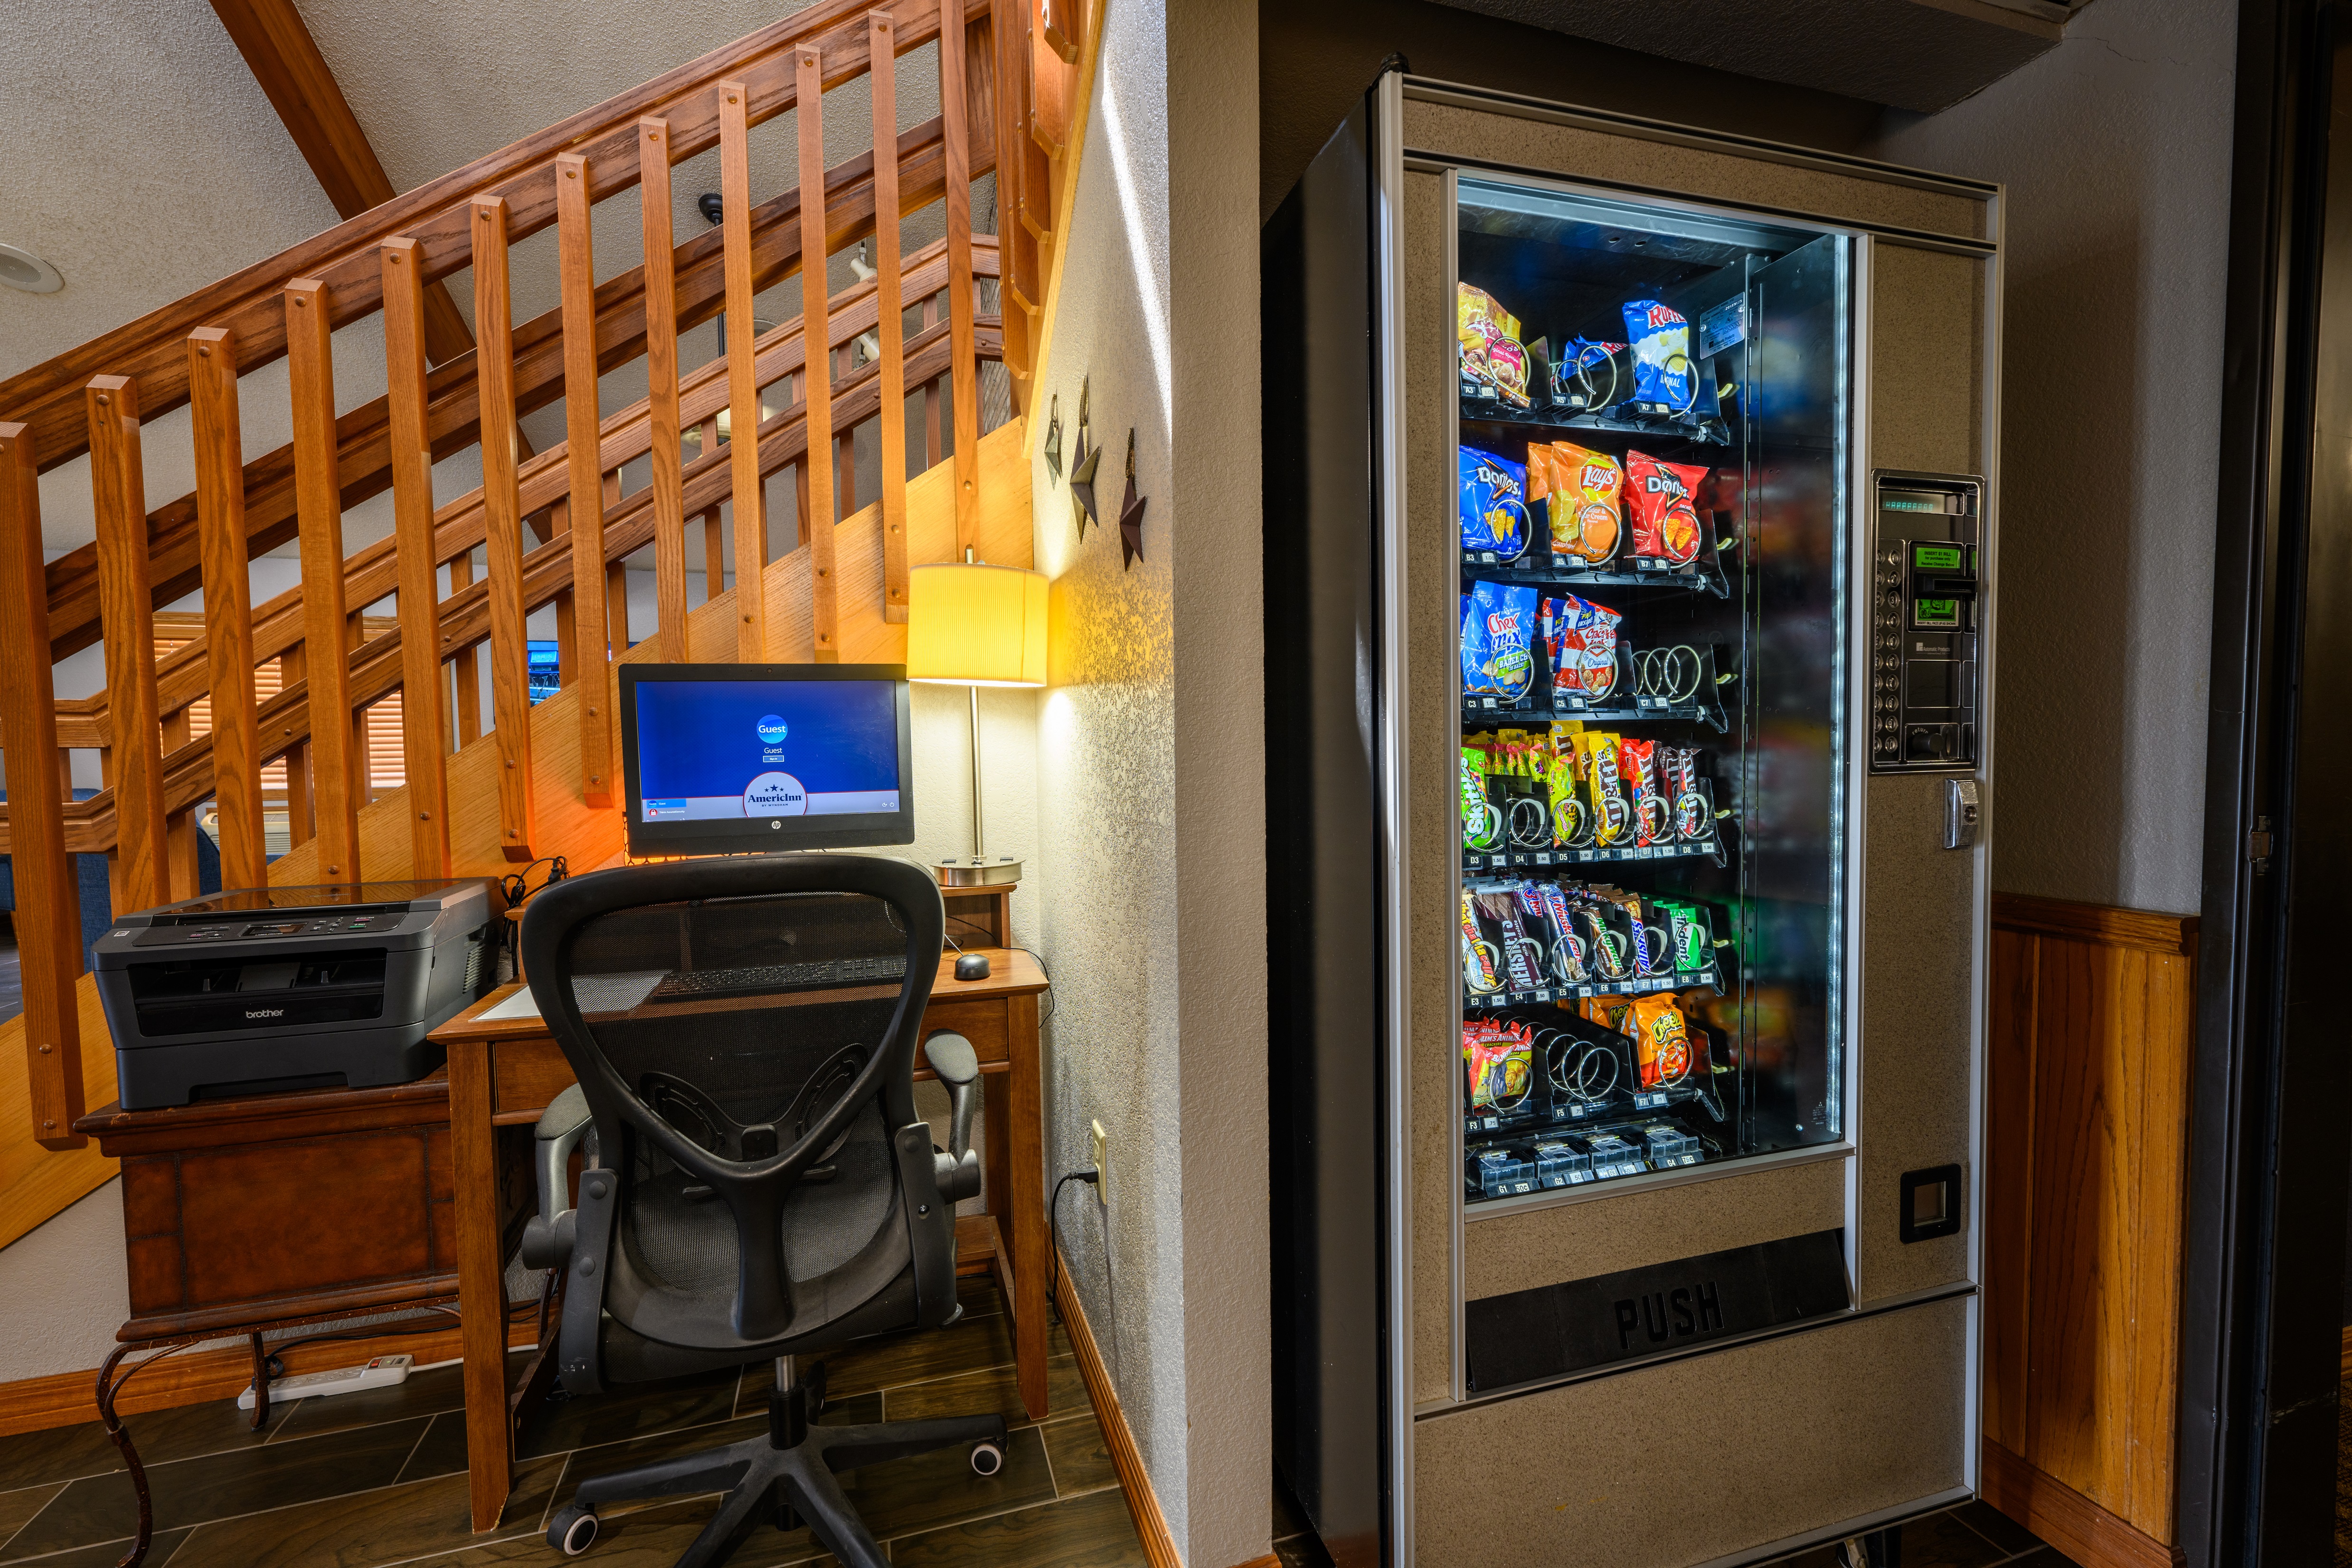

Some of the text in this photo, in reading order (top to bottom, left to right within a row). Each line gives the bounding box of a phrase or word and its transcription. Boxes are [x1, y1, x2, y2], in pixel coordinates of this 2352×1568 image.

[1647, 305, 1687, 329] RUFFL
[1723, 321, 1740, 333] NAMA
[1487, 343, 1519, 364] Oiginal Recipe
[1465, 386, 1474, 394] A3
[1477, 466, 1520, 496] Doritos
[1583, 465, 1615, 491] Lay's
[1488, 613, 1518, 633] Chex
[1492, 629, 1521, 652] mix
[1588, 658, 1608, 668] Original
[758, 725, 786, 733] Guest
[1912, 727, 1928, 735] return
[747, 793, 802, 803] AmericInn
[773, 821, 780, 830] hp
[1524, 888, 1537, 899] 3
[1514, 920, 1525, 944] cocolate
[246, 1010, 283, 1019] brother
[1652, 1011, 1682, 1043] Cheet
[1555, 1177, 1563, 1185] G2
[1516, 1184, 1528, 1193] 50¢
[1616, 1281, 1725, 1351] PUSH
